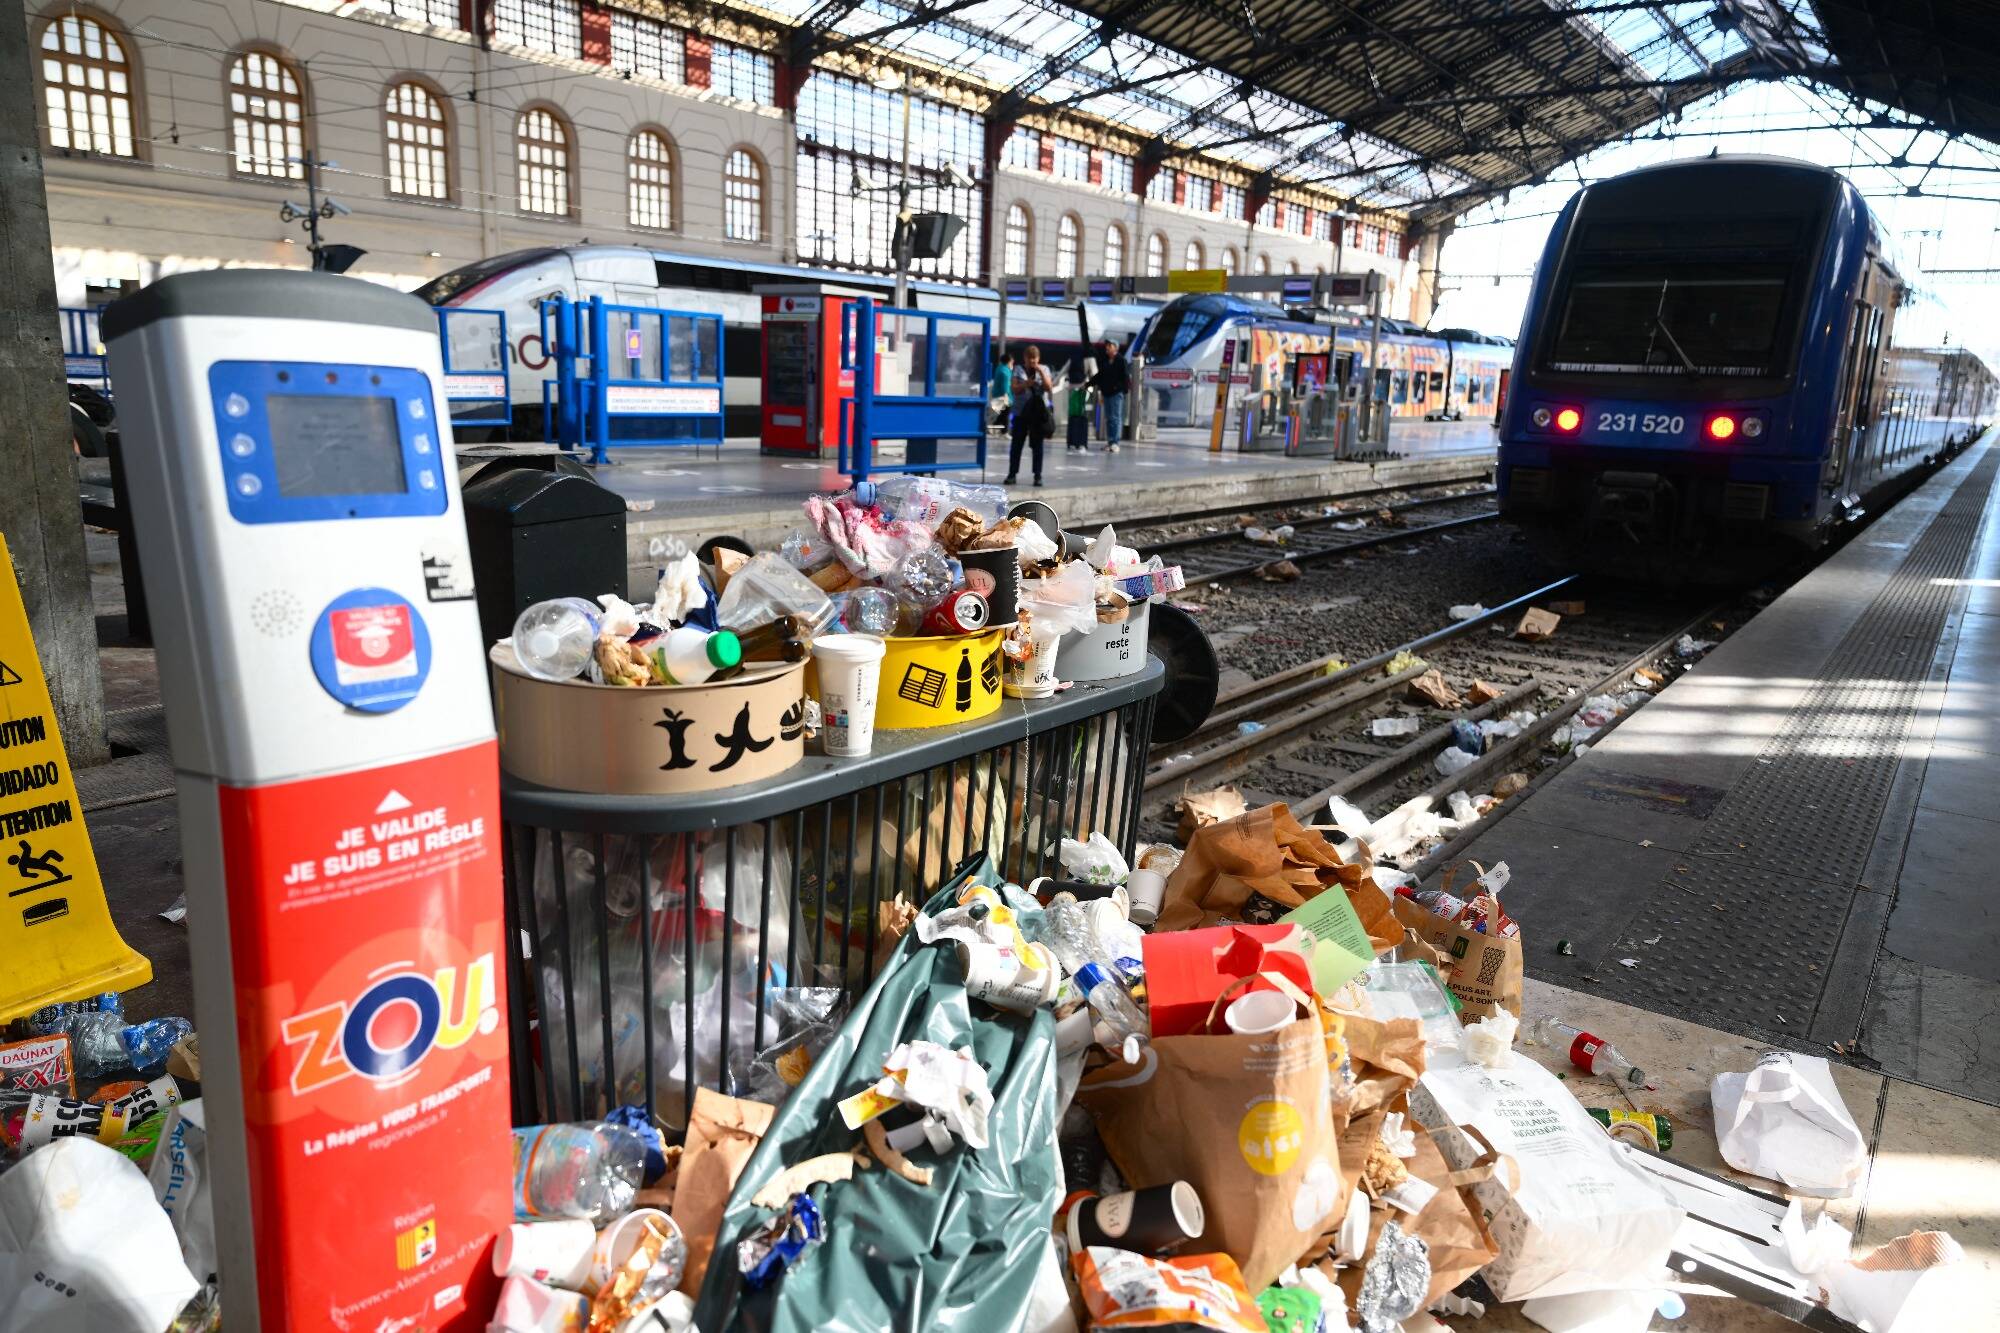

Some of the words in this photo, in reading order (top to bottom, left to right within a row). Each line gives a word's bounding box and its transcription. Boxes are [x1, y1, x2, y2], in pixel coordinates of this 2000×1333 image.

[1598, 413, 1635, 432] 231
[1642, 414, 1684, 434] 520
[1122, 624, 1130, 634] le
[1105, 637, 1129, 649] reste
[1119, 649, 1129, 660] ici
[336, 827, 365, 850] JE
[371, 806, 447, 842] VALIDE
[284, 860, 316, 884] JE
[324, 848, 382, 877] SUIS
[388, 838, 420, 862] EN
[424, 817, 484, 851] RÈGLE
[1453, 982, 1473, 992] PLUS
[281, 952, 499, 1097] ZOU!
[2, 1046, 55, 1064] DAUNAT
[13, 1056, 70, 1090] XXL
[304, 1140, 324, 1156] La
[326, 1120, 378, 1149] Région
[382, 1103, 418, 1128] VOUS
[420, 1066, 493, 1113] TRANSPORTE
[1510, 1116, 1560, 1128] BOULANGER
